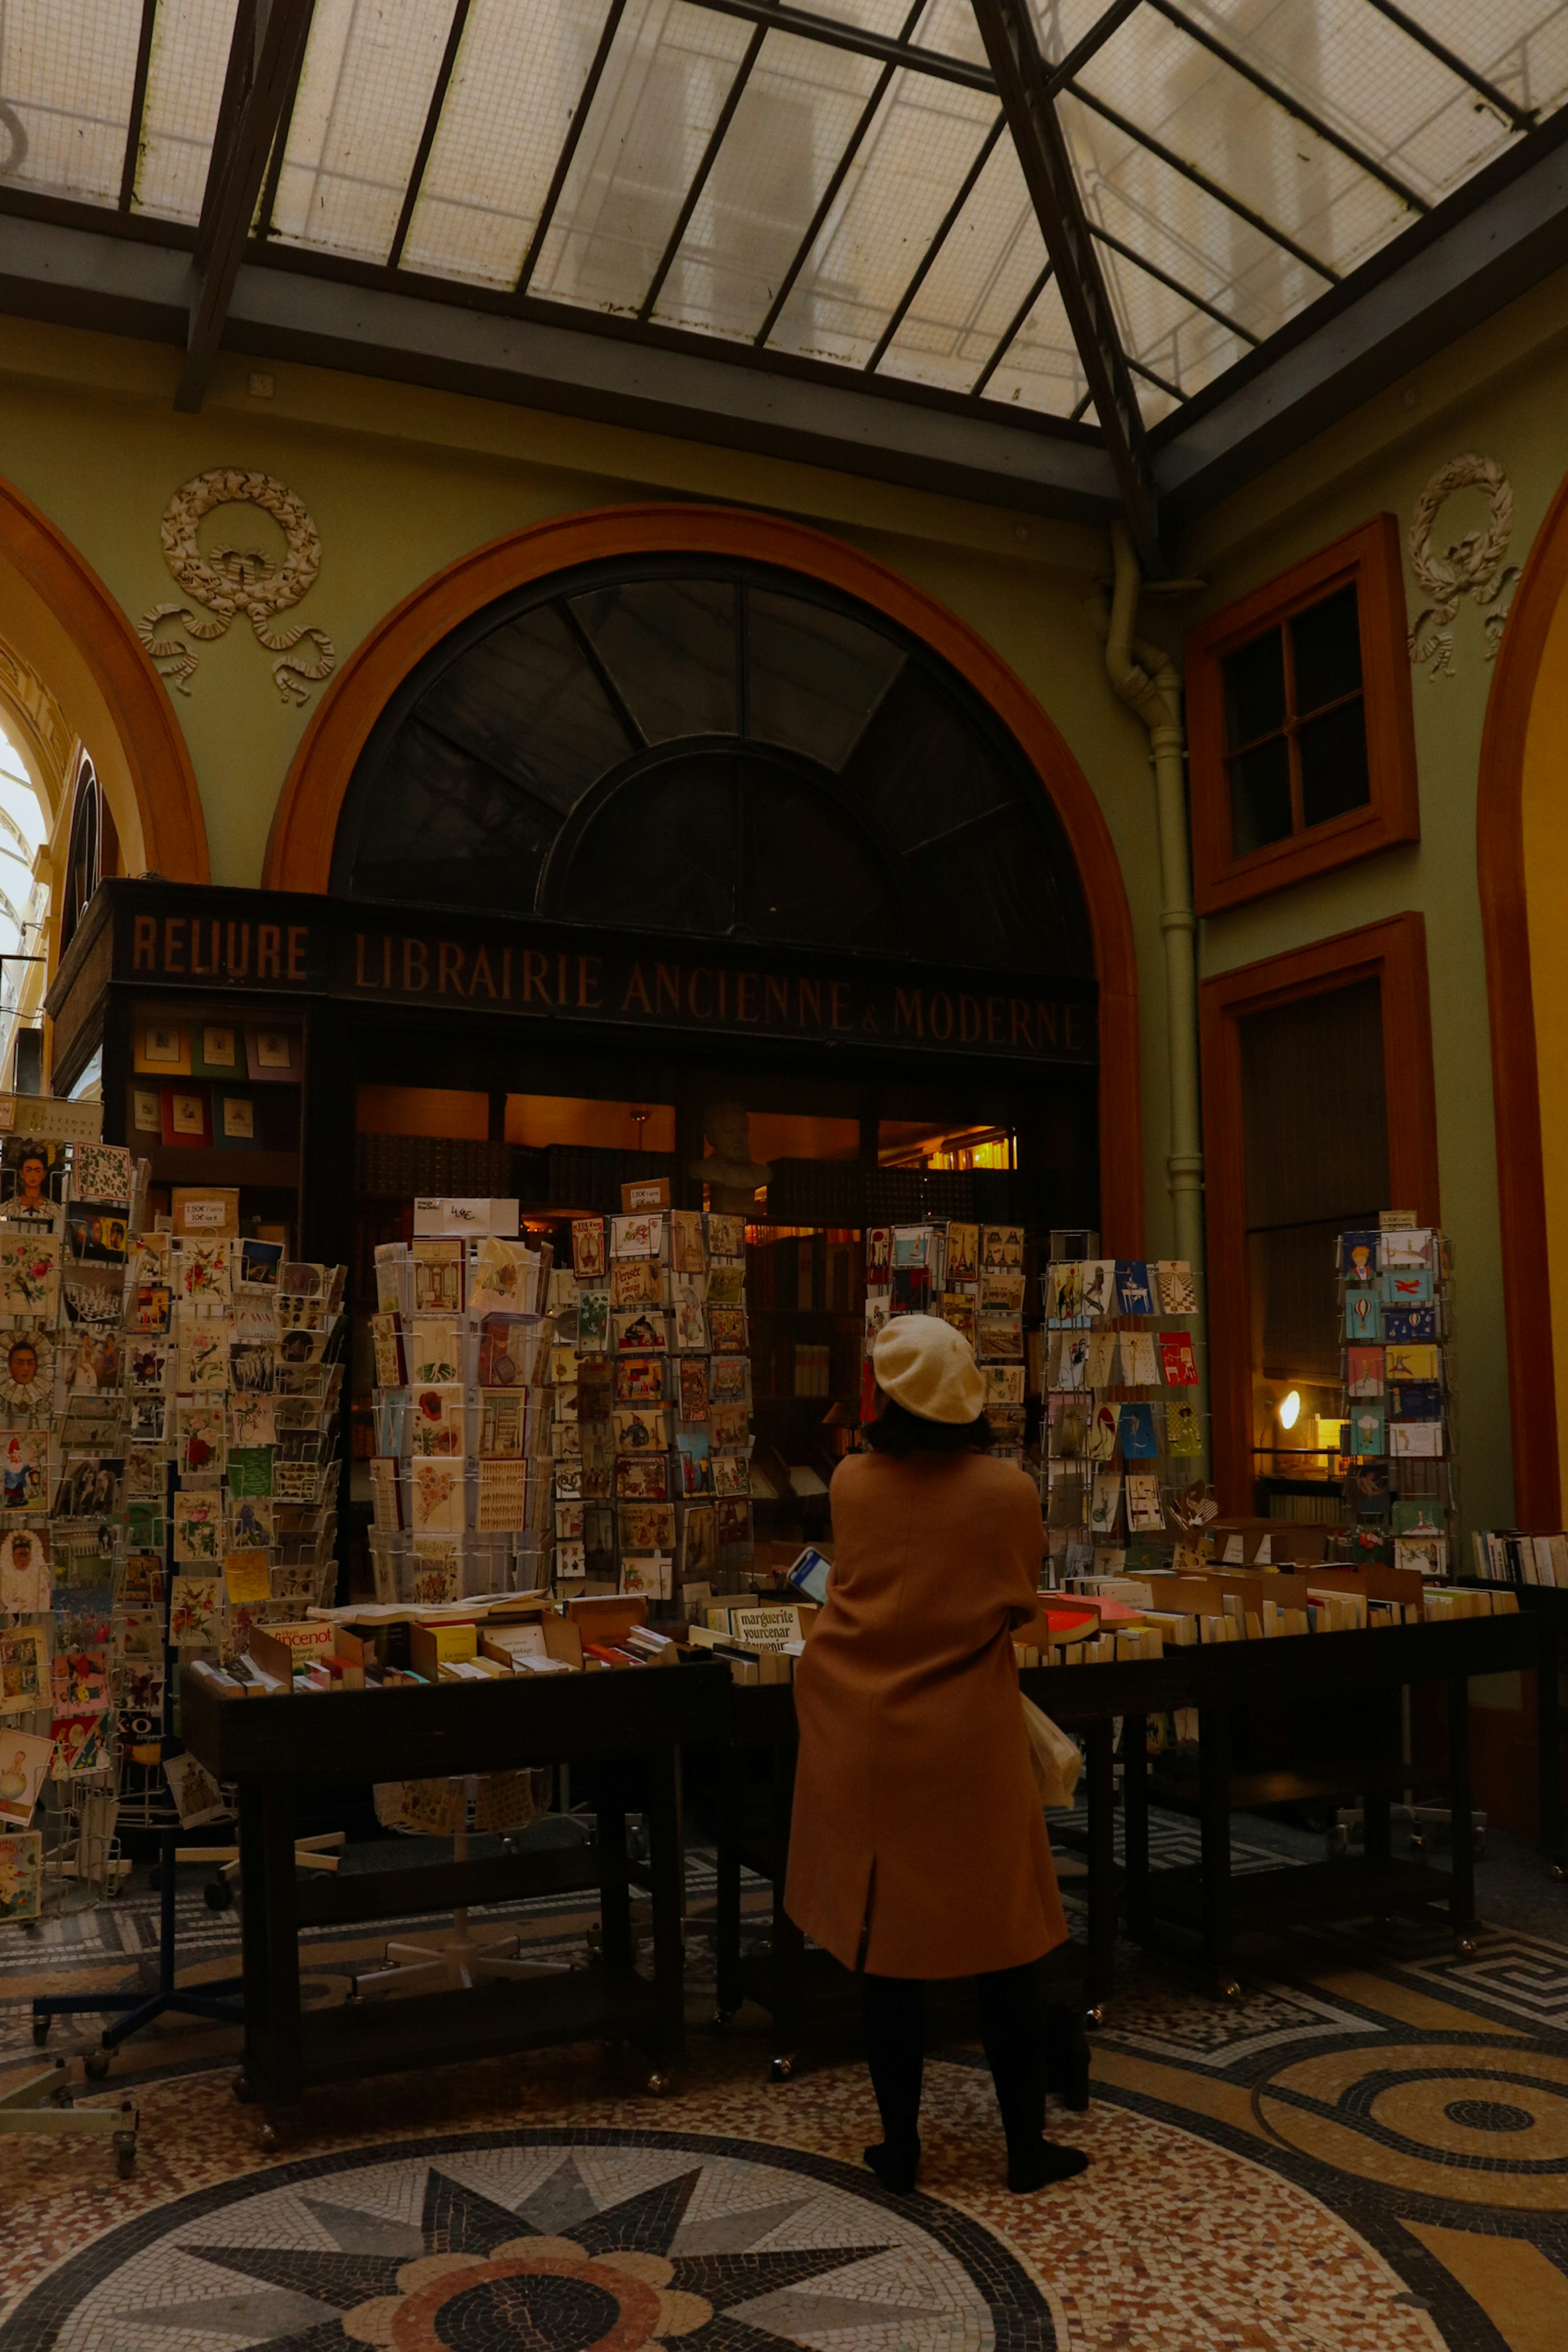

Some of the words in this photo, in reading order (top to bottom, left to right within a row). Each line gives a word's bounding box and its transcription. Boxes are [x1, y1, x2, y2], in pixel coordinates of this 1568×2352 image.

[132, 915, 309, 981] RELIURE
[353, 933, 603, 1009] LIBRAIRIE
[621, 959, 853, 1031] ANCIENNE
[862, 1003, 876, 1033] &
[893, 987, 1083, 1051] MODERNE
[741, 1610, 794, 1628] marguerite
[743, 1628, 790, 1641] yourcenar
